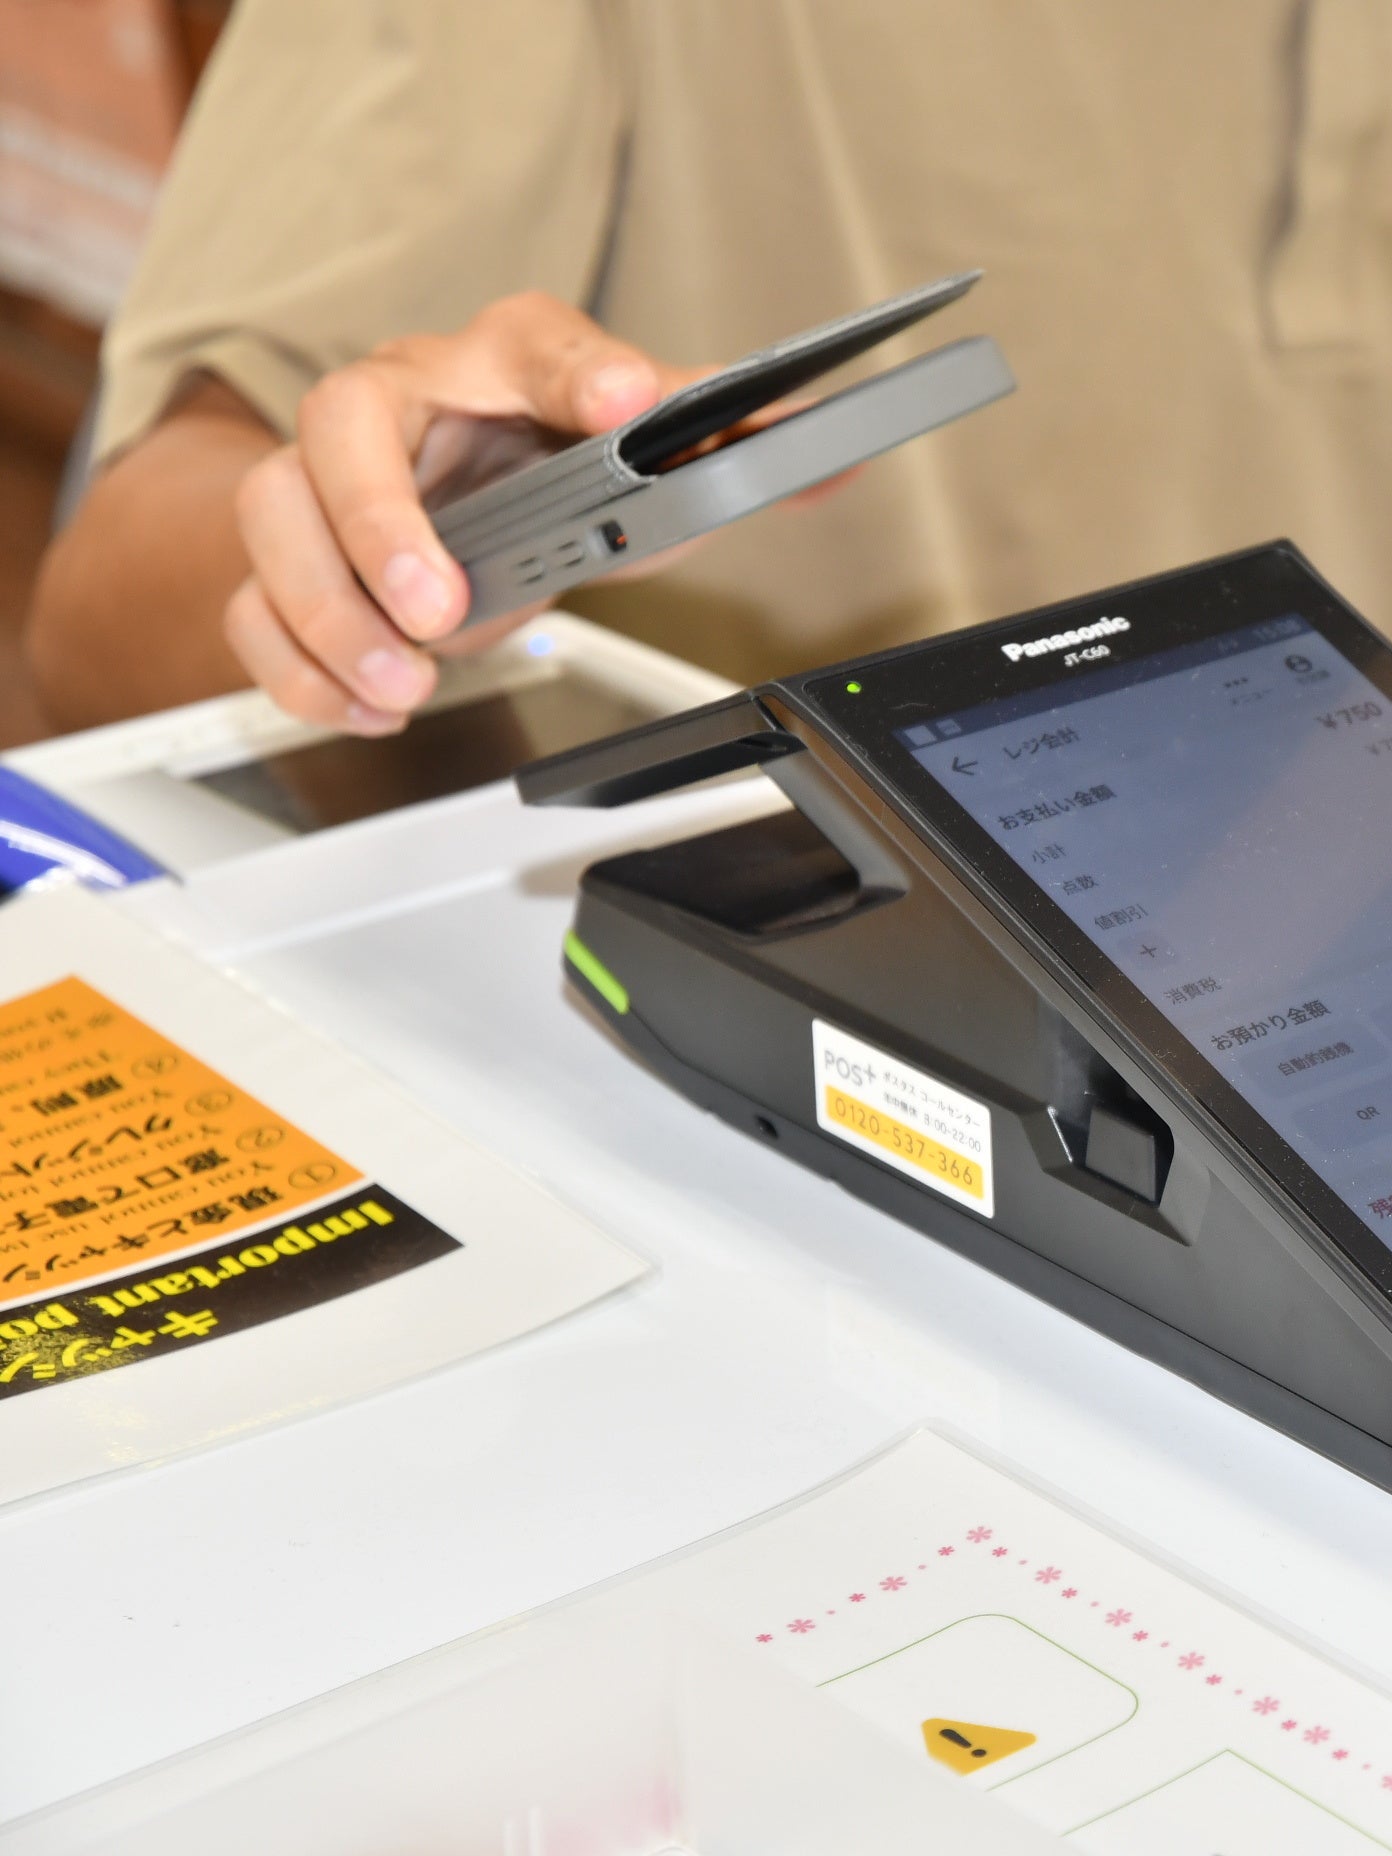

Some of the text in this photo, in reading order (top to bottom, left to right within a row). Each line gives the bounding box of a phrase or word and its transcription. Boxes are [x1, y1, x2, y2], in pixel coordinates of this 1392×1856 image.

[1001, 616, 1131, 662] Panasonic
[1063, 644, 1111, 667] JT-C60
[1316, 701, 1383, 729] ¥750
[1002, 726, 1080, 760] レジ会計
[997, 783, 1119, 831] お支払い金額
[1031, 841, 1067, 864] 小計
[1062, 874, 1100, 896] 点数
[1094, 903, 1150, 931] 値割引
[1163, 975, 1223, 1005] 消費税
[1210, 998, 1333, 1051] お預かり金額
[823, 1048, 878, 1088] POS+
[1356, 1105, 1381, 1121] QR
[834, 1096, 975, 1187] 0120-537-366
[0, 1146, 231, 1236] 窓口で電子
[2, 1184, 284, 1284] 現金とキャッシ
[89, 1200, 396, 1319] Important
